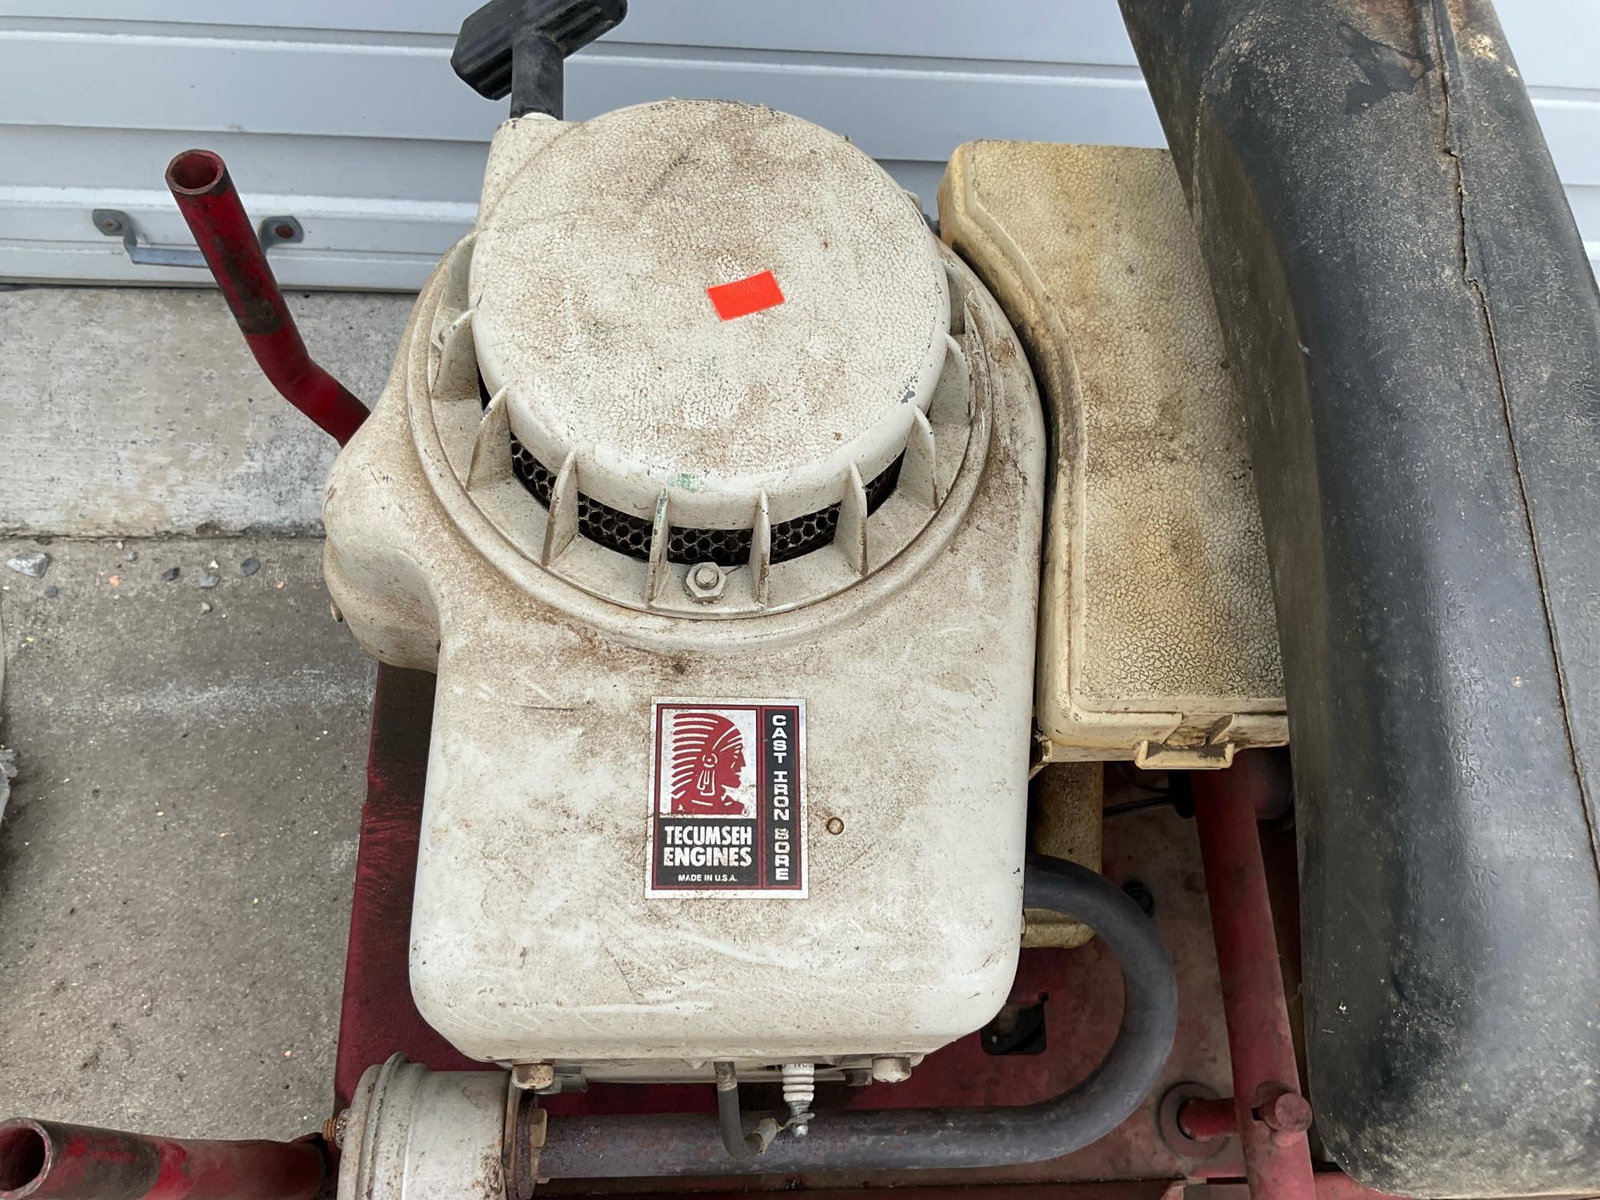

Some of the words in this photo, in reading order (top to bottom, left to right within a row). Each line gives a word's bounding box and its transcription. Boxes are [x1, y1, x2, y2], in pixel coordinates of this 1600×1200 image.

[771, 714, 788, 764] CAST
[773, 770, 790, 821] IRON
[664, 825, 753, 846] TECUMSEH
[663, 846, 753, 867] ENGINES
[774, 827, 791, 881] BORE
[677, 873, 702, 882] MADE
[703, 873, 713, 882] IN
[714, 874, 738, 882] U.S.A.
